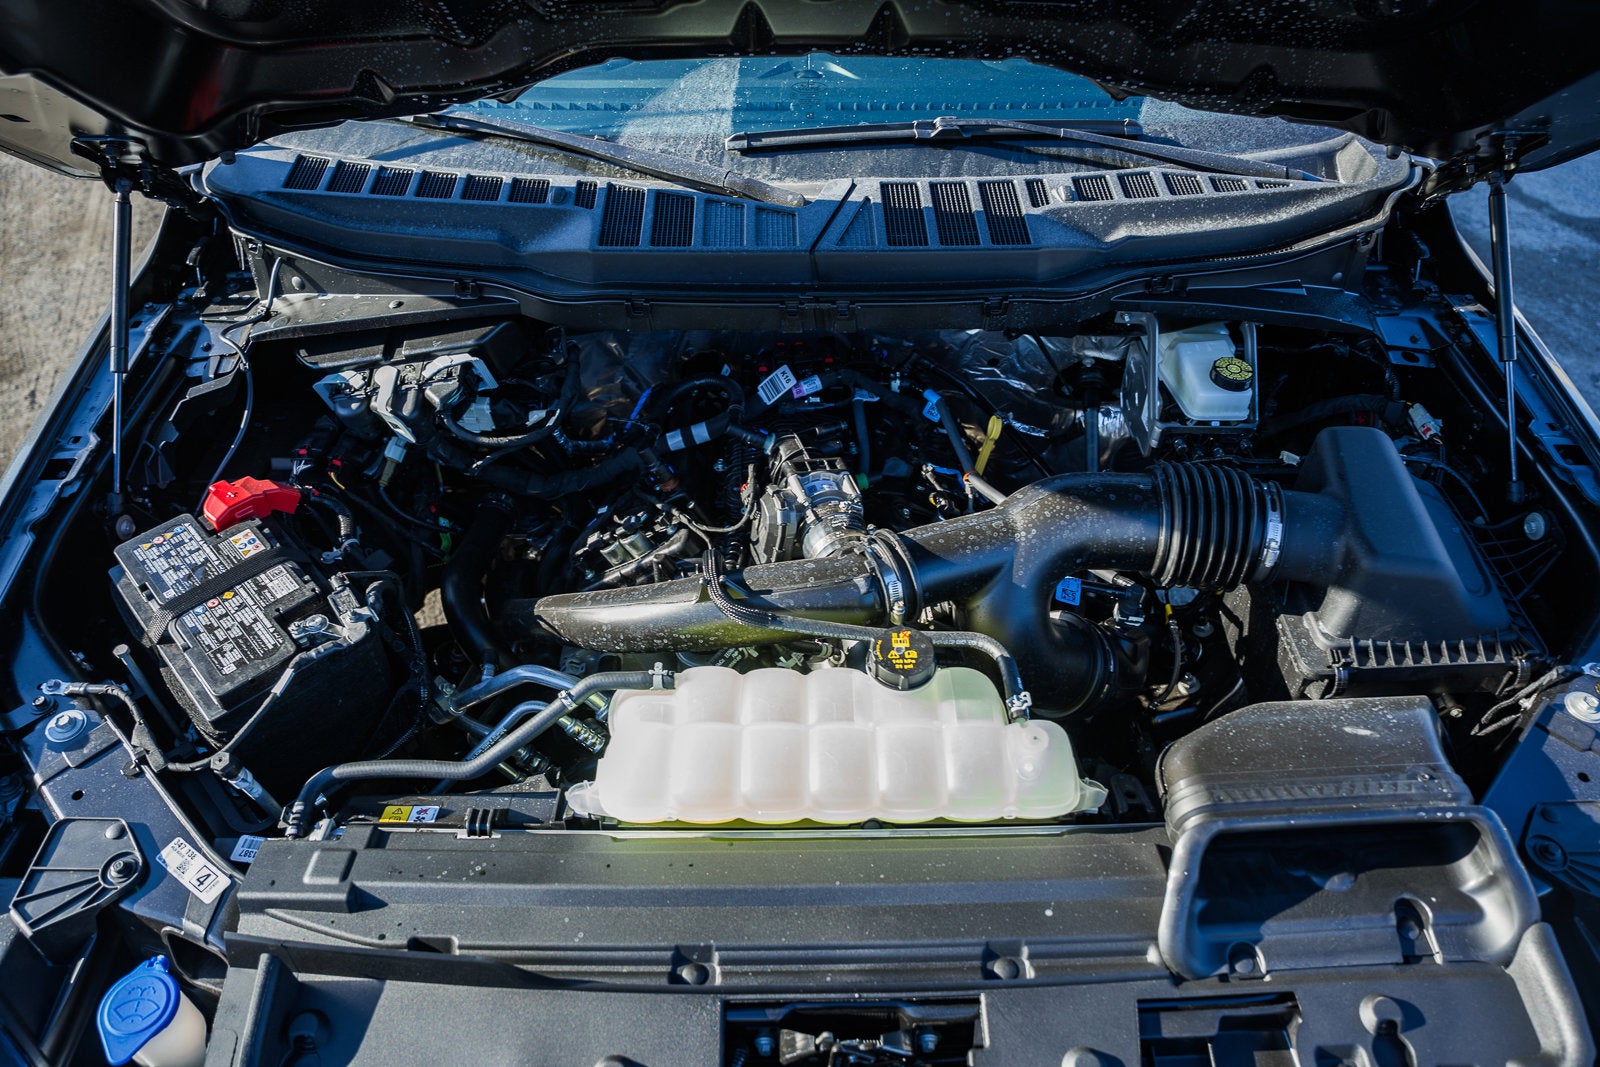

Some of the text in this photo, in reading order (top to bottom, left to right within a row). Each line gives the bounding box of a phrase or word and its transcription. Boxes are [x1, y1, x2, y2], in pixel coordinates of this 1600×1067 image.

[780, 371, 792, 384] K16
[173, 839, 187, 850] 347
[196, 873, 212, 887] 4
